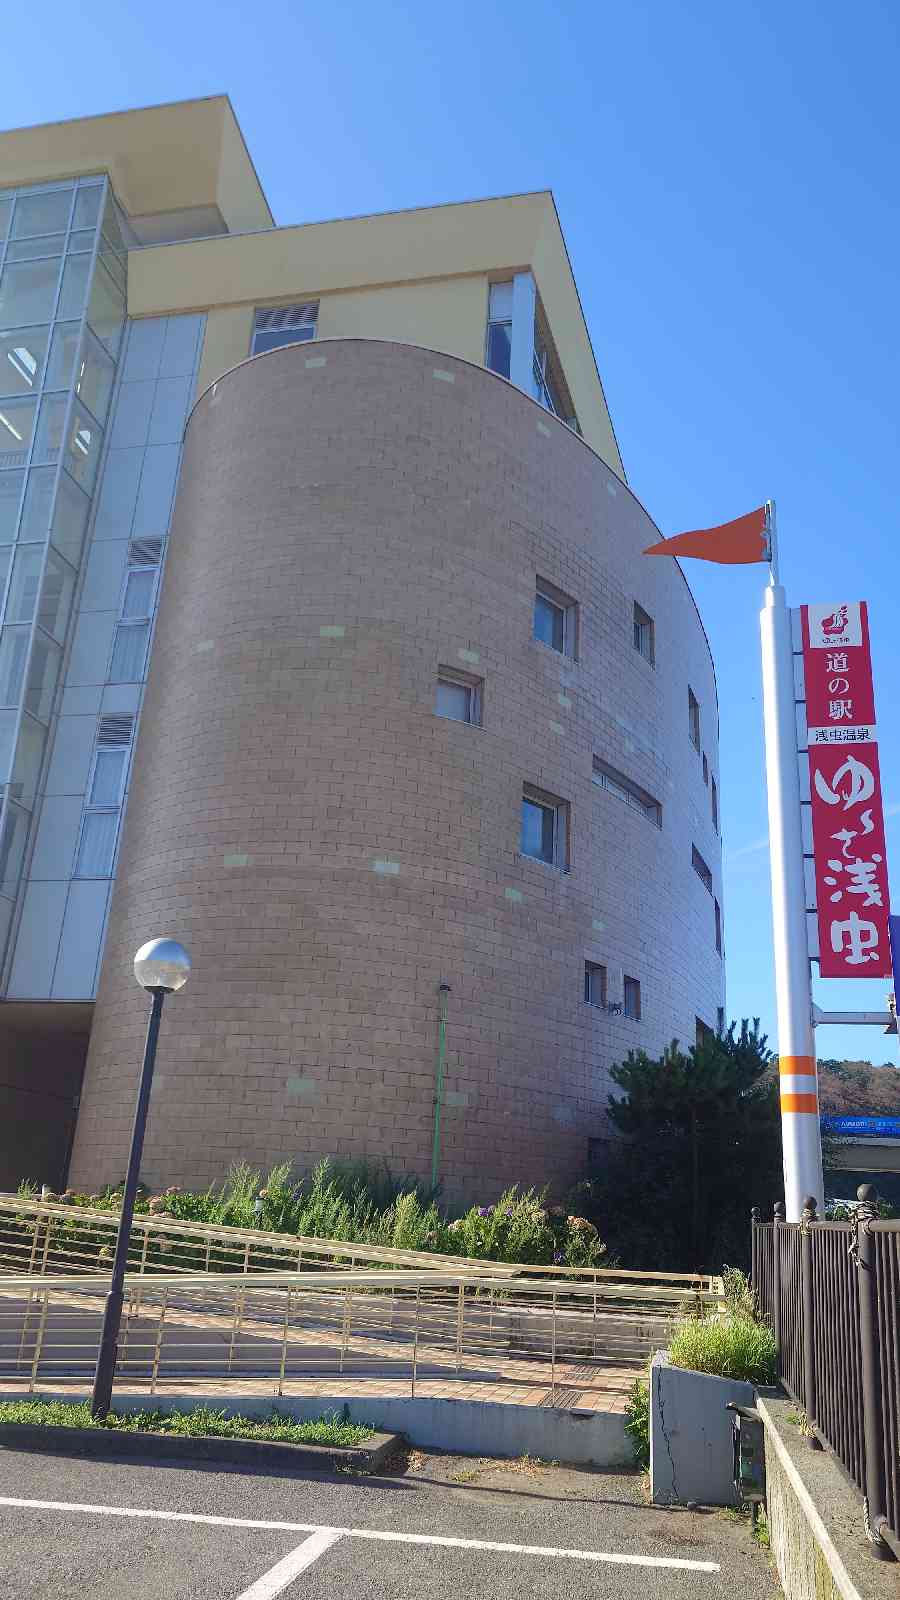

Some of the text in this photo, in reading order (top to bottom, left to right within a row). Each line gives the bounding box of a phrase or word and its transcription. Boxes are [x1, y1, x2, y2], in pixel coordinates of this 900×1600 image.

[825, 652, 853, 720] 道の駅
[815, 728, 872, 742] 浅虫温泉
